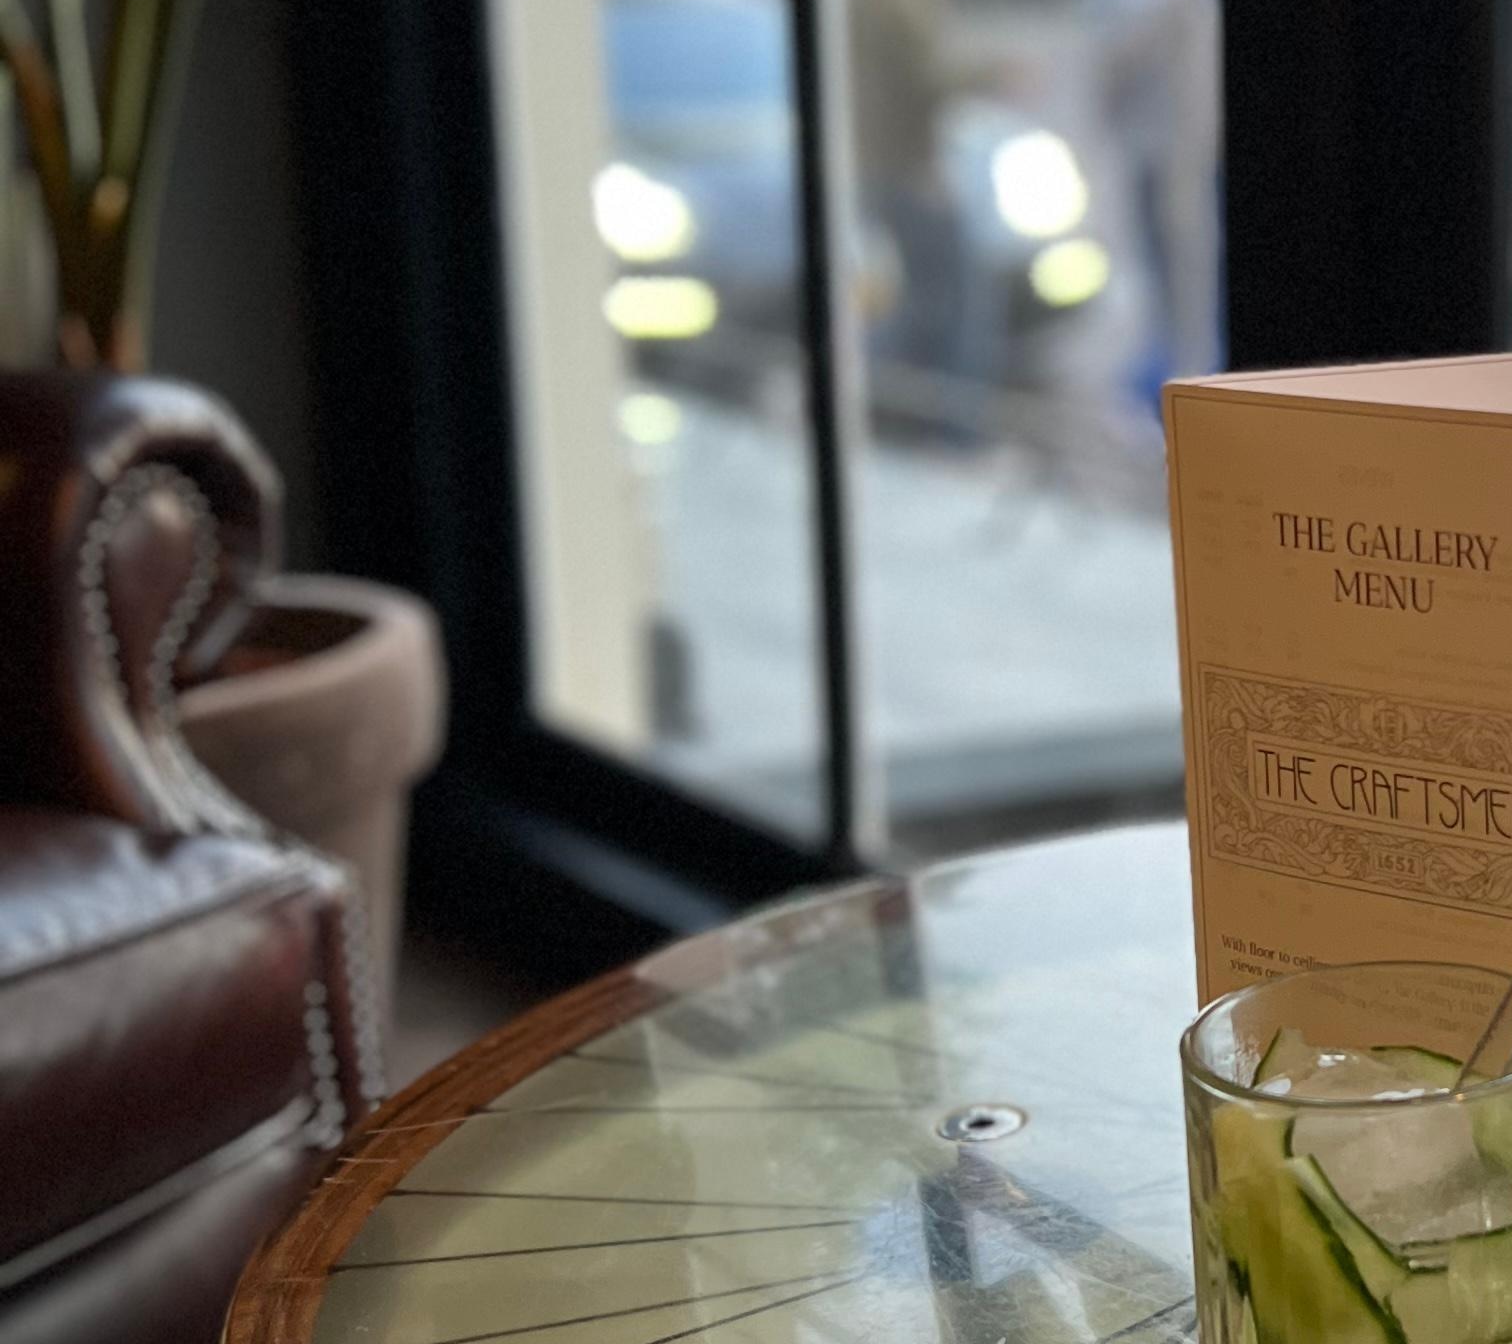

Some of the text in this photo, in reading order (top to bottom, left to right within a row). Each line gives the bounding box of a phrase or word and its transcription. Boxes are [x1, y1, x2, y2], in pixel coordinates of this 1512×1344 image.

[1272, 512, 1336, 553] THE
[1346, 521, 1498, 572] GALLERY
[1333, 568, 1435, 614] MENU
[1257, 749, 1317, 805] THE
[1221, 934, 1247, 955] With
[1249, 941, 1276, 959] floor
[1278, 951, 1291, 964] to
[1230, 959, 1262, 977] views
